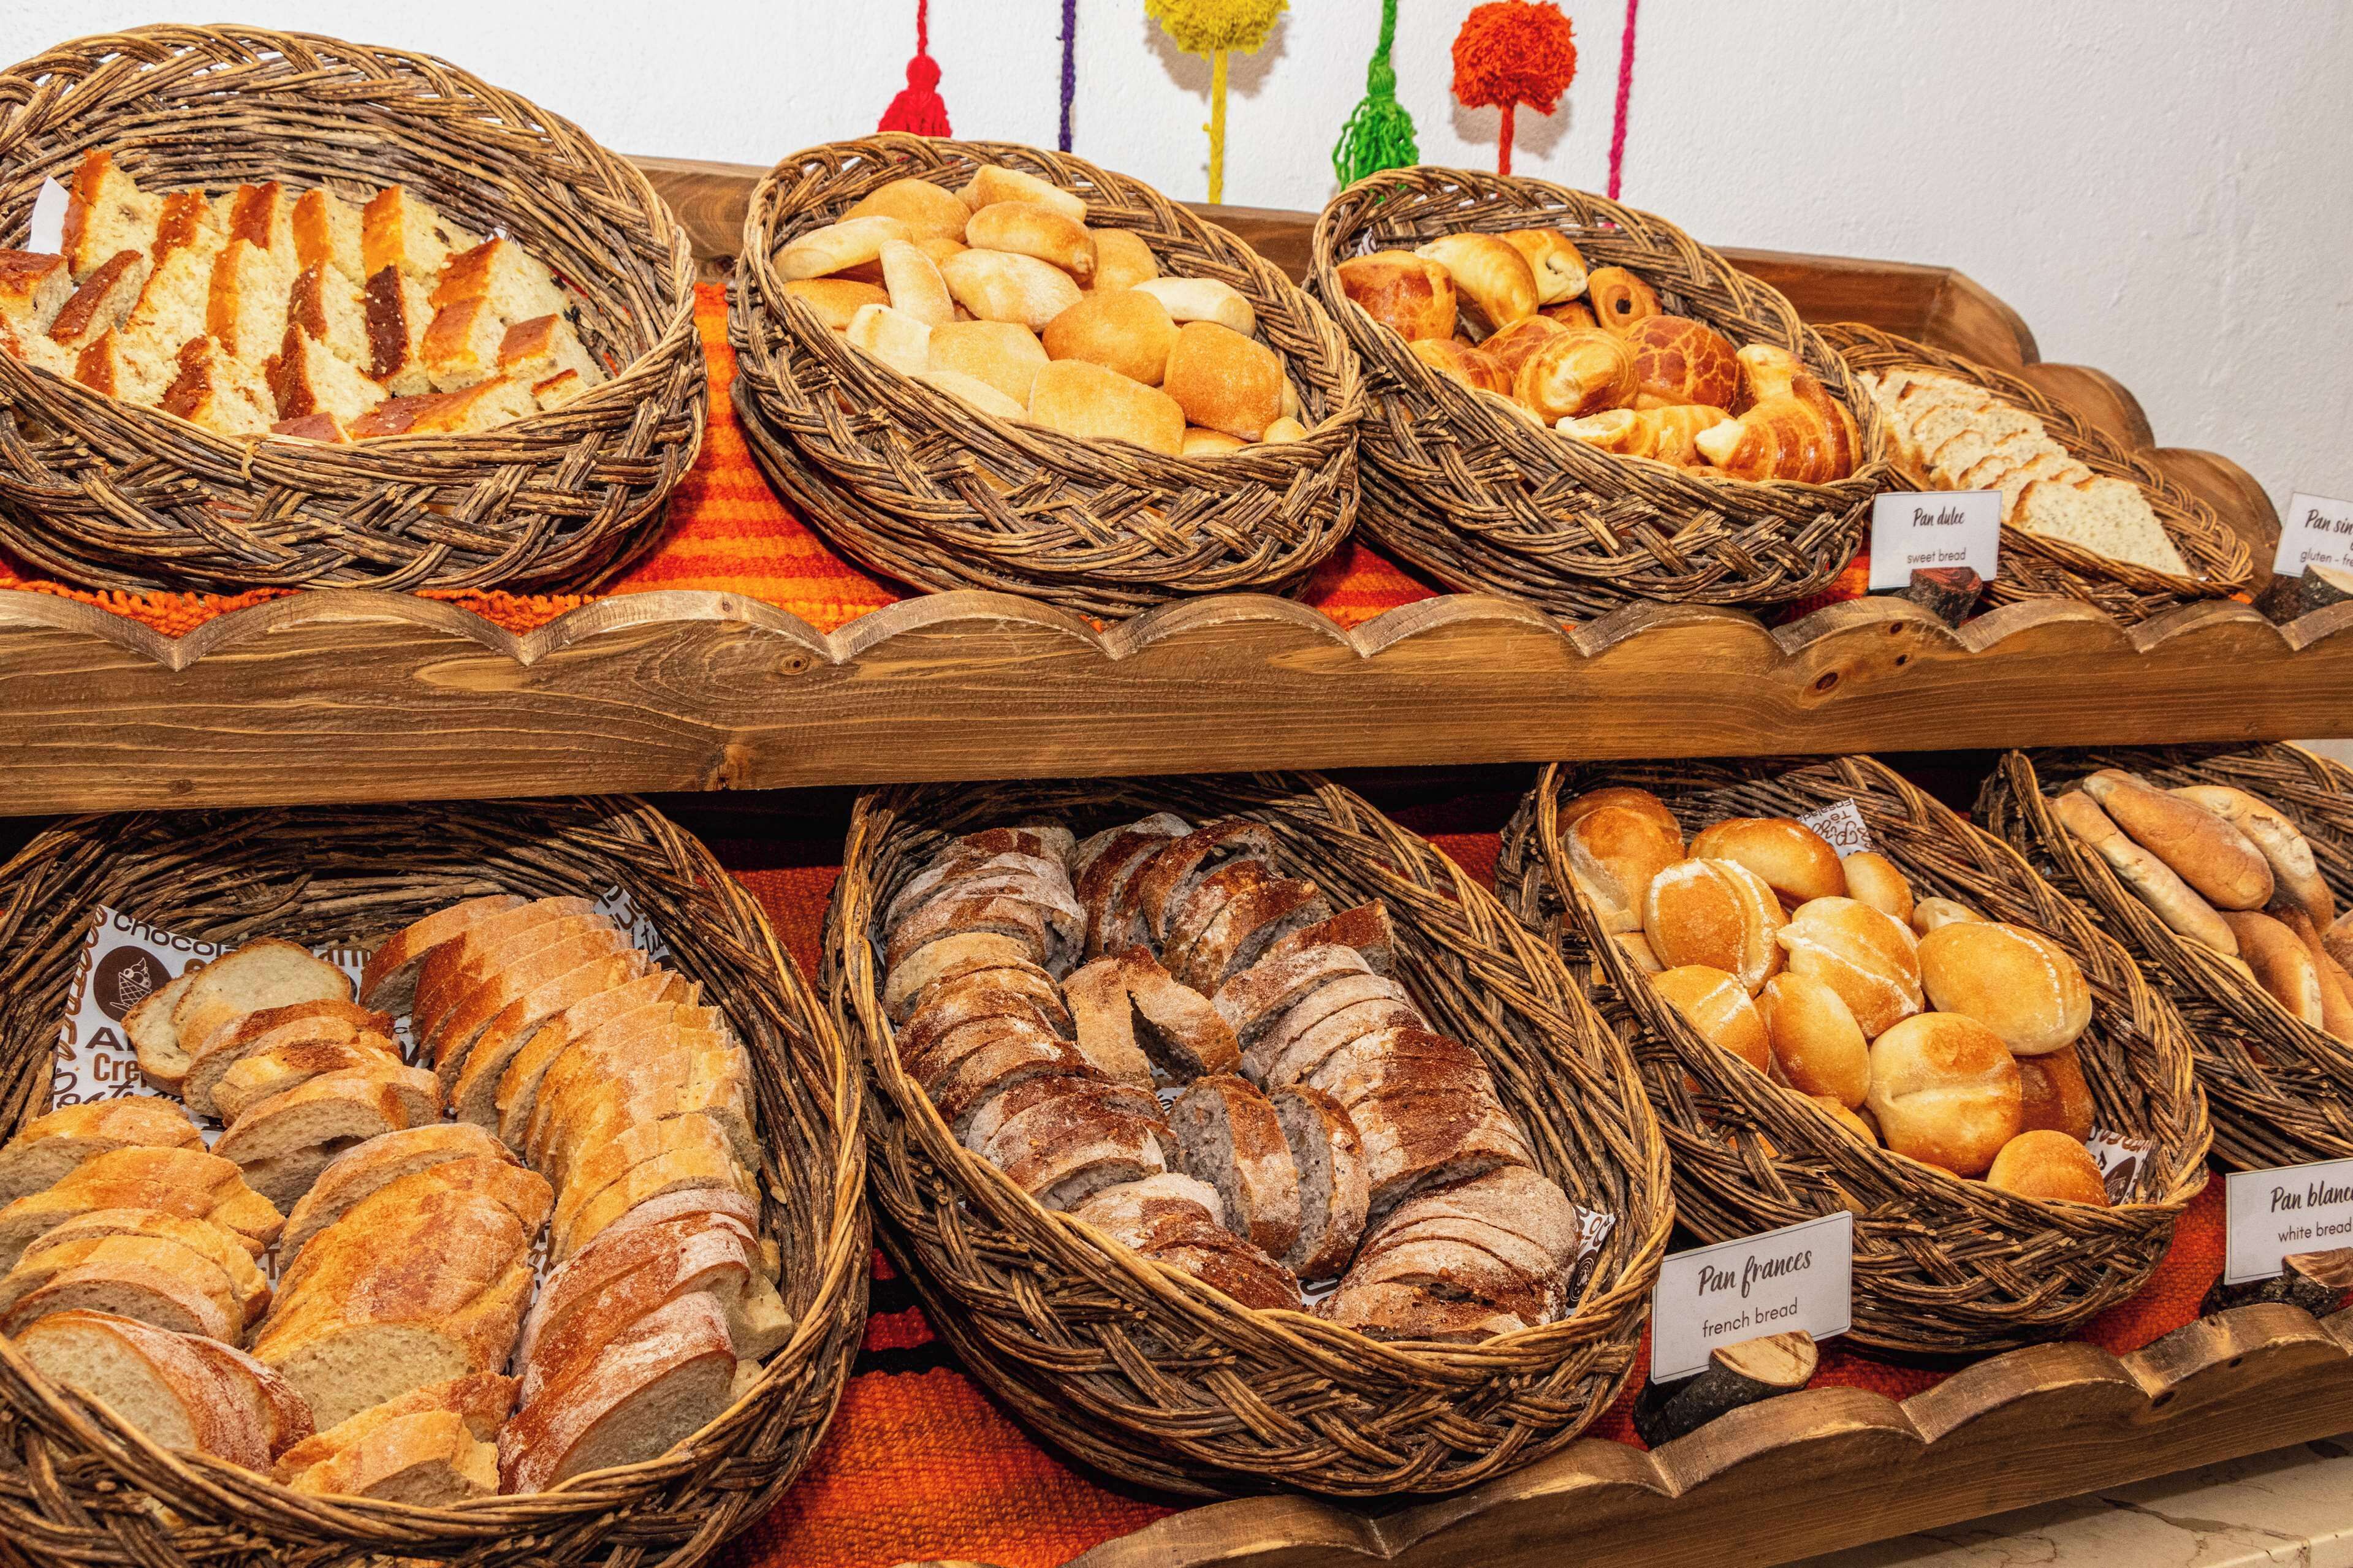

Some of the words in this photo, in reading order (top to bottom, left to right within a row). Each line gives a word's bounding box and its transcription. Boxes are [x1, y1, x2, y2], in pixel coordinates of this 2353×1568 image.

[1914, 507, 1934, 527] Pan
[1937, 506, 1965, 525] dulce
[2305, 509, 2331, 532] Pan
[1907, 551, 1936, 564] sweet
[1939, 547, 1966, 562] bread
[2300, 548, 2332, 563] gluten
[2270, 1186, 2302, 1213] Pan
[2278, 1225, 2312, 1243] white
[2316, 1216, 2352, 1237] bread
[1698, 1265, 1736, 1296] Pan
[1741, 1250, 1812, 1298] frances
[1703, 1310, 1750, 1338] french
[1755, 1297, 1798, 1324] bread
